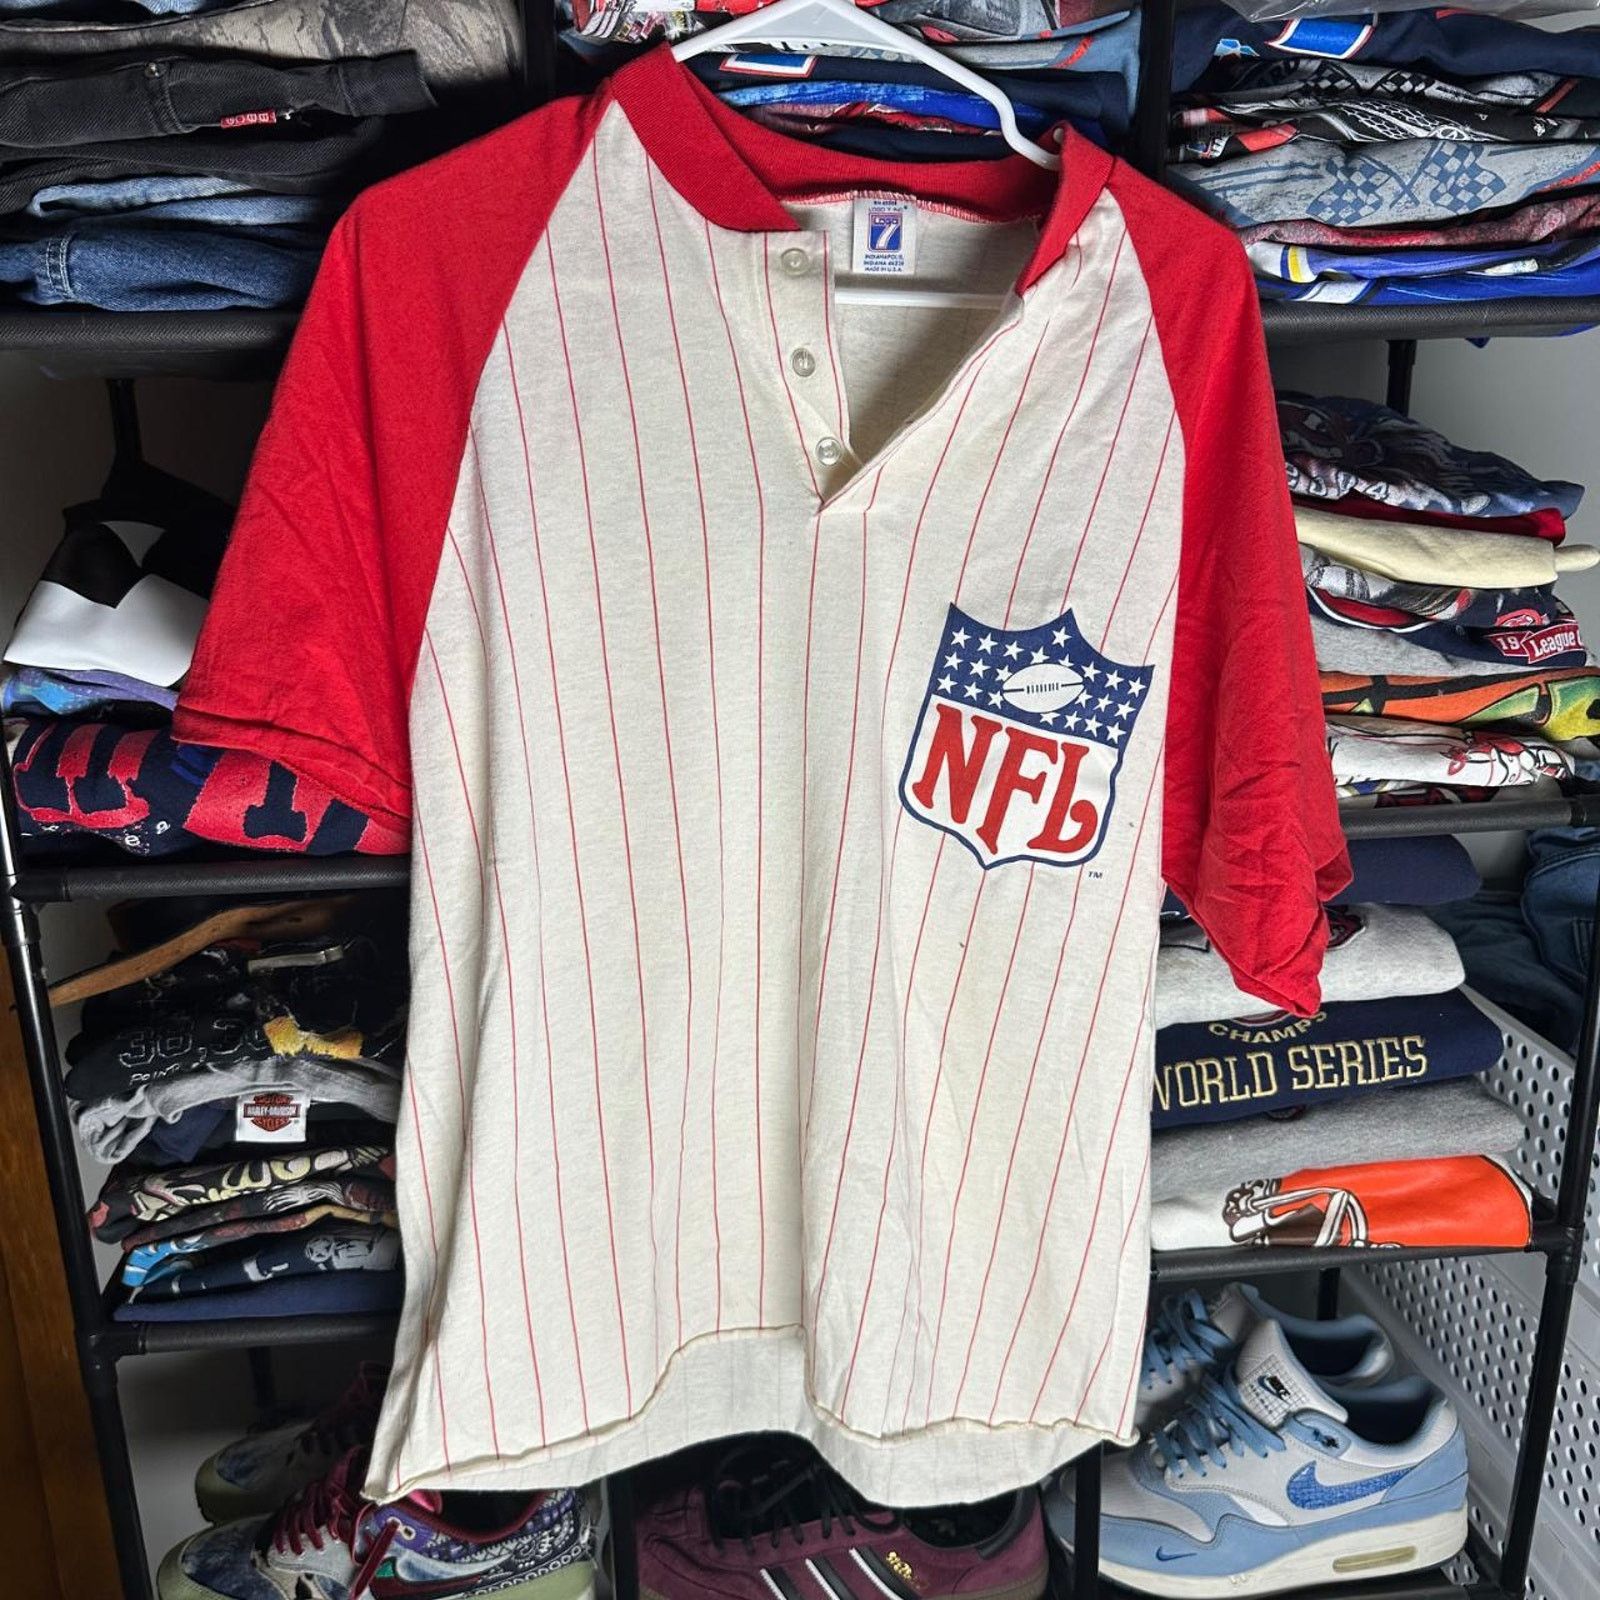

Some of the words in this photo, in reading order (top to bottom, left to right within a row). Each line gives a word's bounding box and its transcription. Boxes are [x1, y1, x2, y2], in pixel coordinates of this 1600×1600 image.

[1529, 631, 1575, 657] League
[912, 703, 1098, 855] NFL
[1287, 1034, 1428, 1091] SERIES
